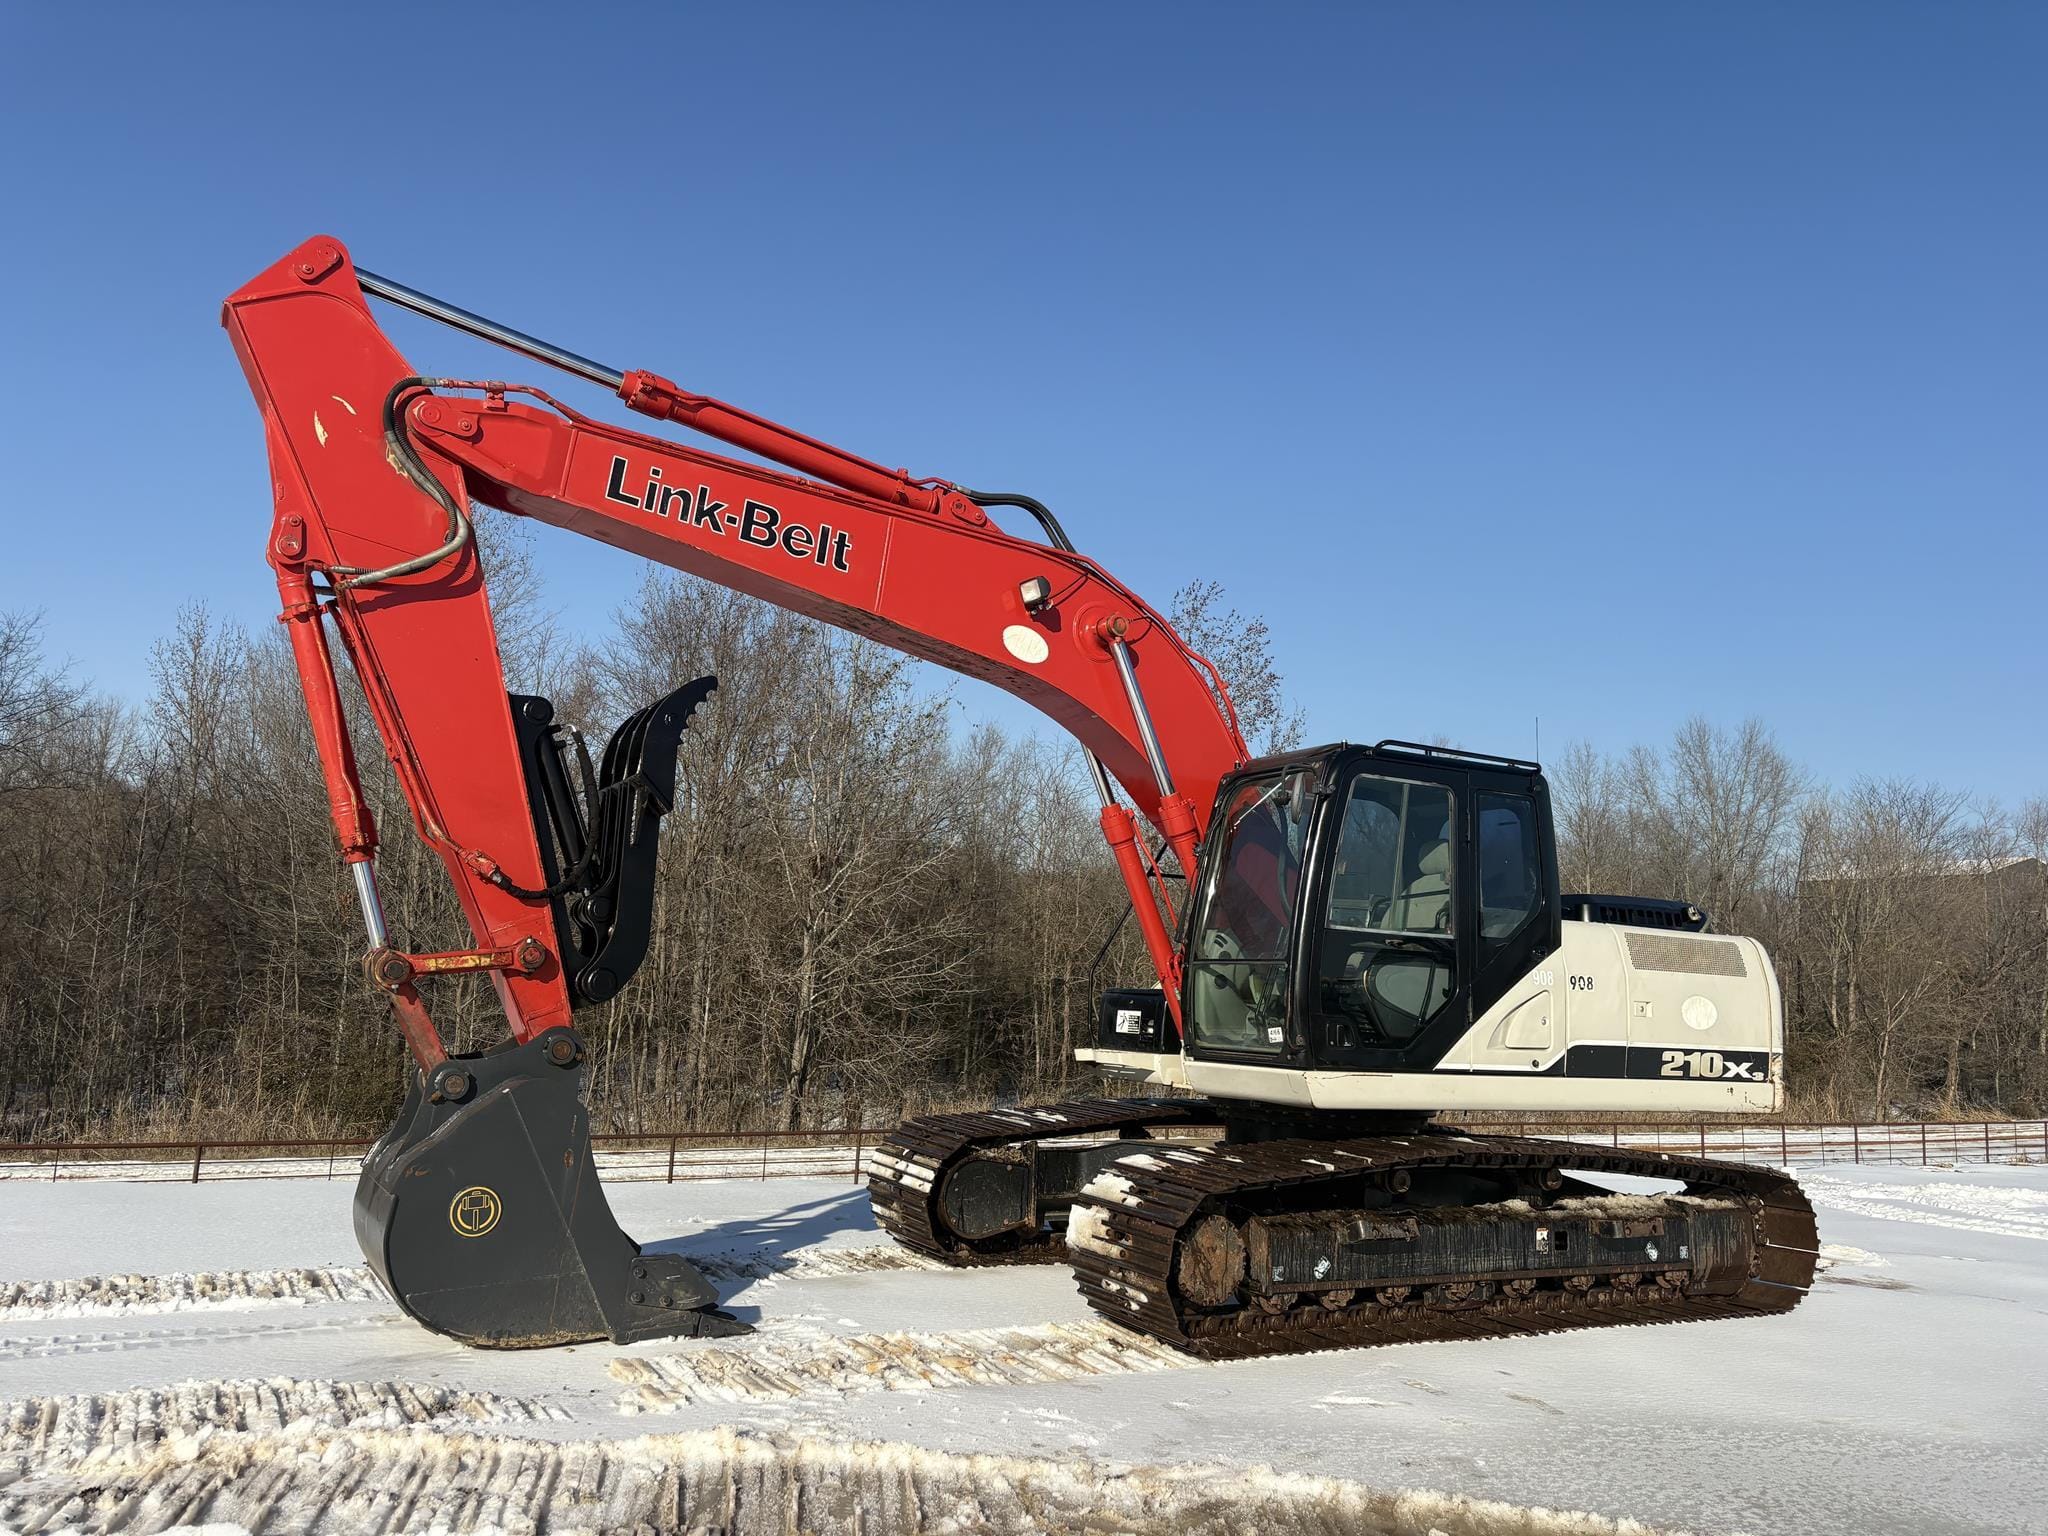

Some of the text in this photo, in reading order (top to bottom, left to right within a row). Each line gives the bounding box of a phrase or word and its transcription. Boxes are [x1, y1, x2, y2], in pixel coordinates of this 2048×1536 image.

[605, 455, 852, 573] Link-Belt
[1532, 970, 1553, 986] 908
[1569, 975, 1594, 991] 908
